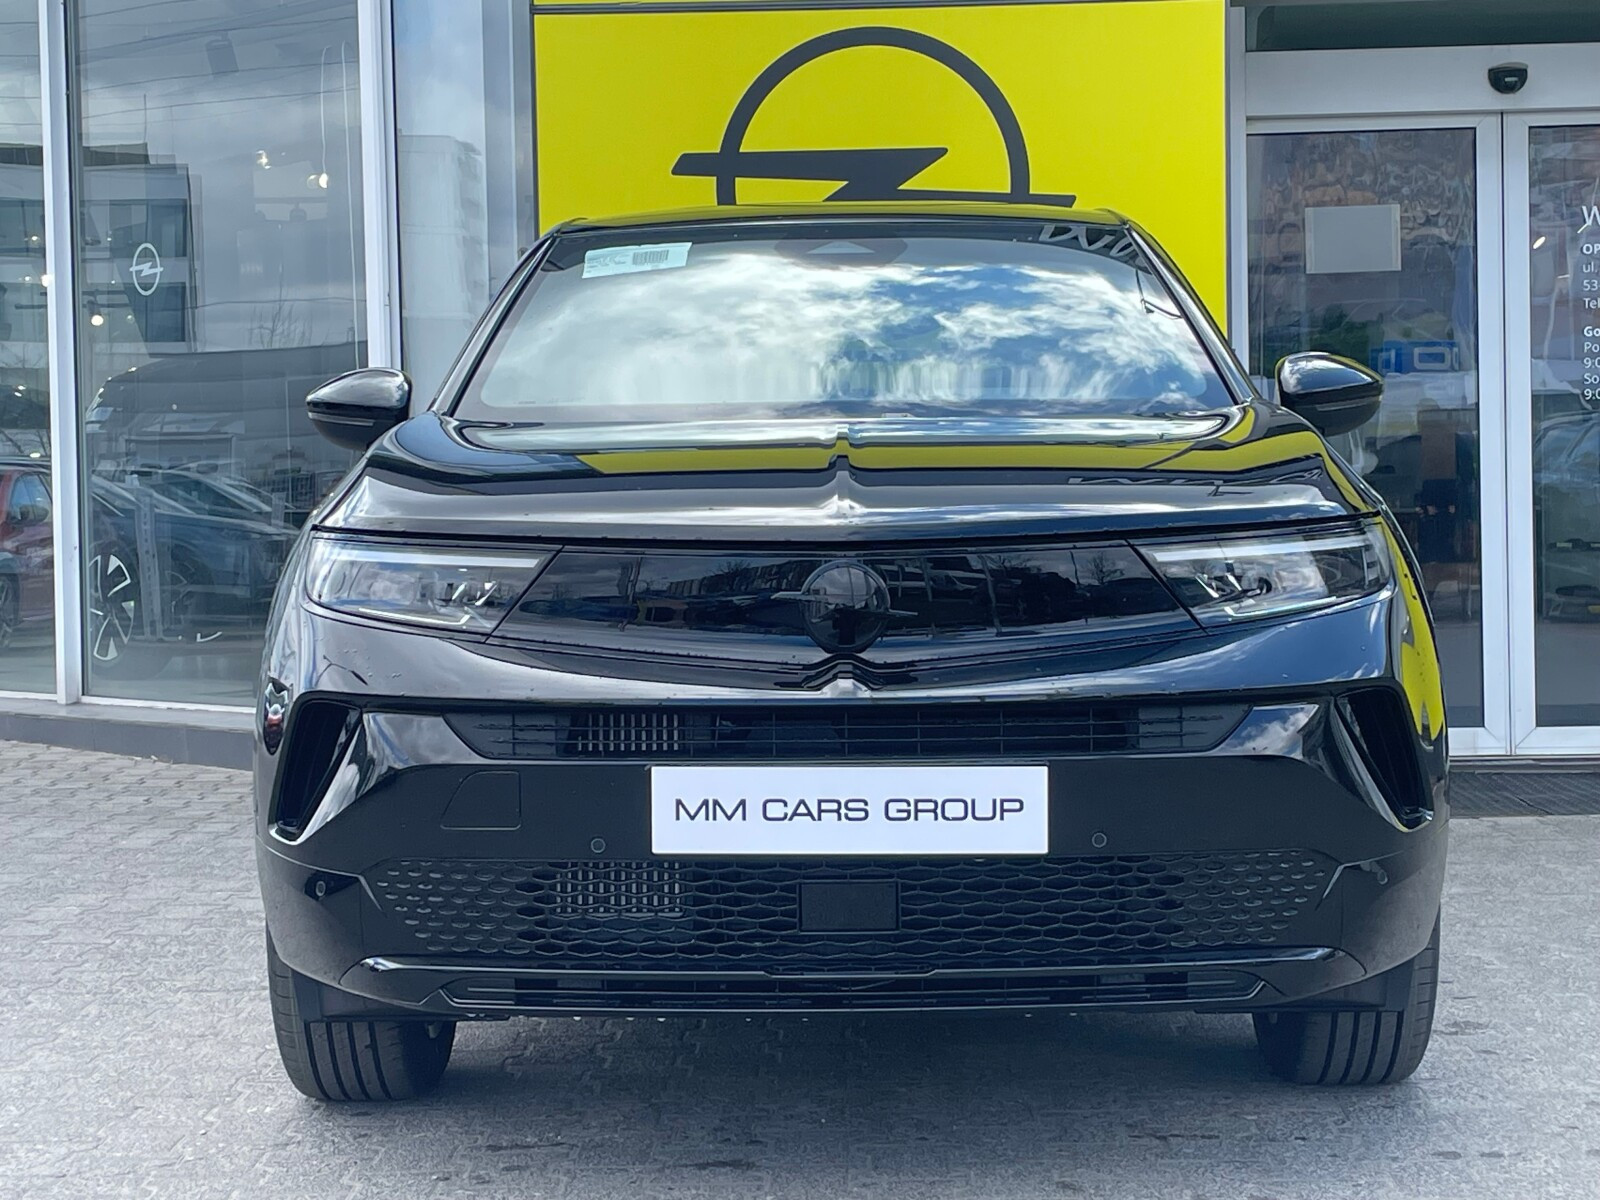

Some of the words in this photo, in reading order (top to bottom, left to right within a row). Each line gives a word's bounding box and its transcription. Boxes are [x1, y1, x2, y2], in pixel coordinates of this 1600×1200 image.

[1583, 261, 1598, 273] ul.
[1583, 279, 1600, 291] 53
[675, 798, 747, 822] MM
[762, 798, 869, 822] CARS
[884, 798, 1025, 822] GROUP
